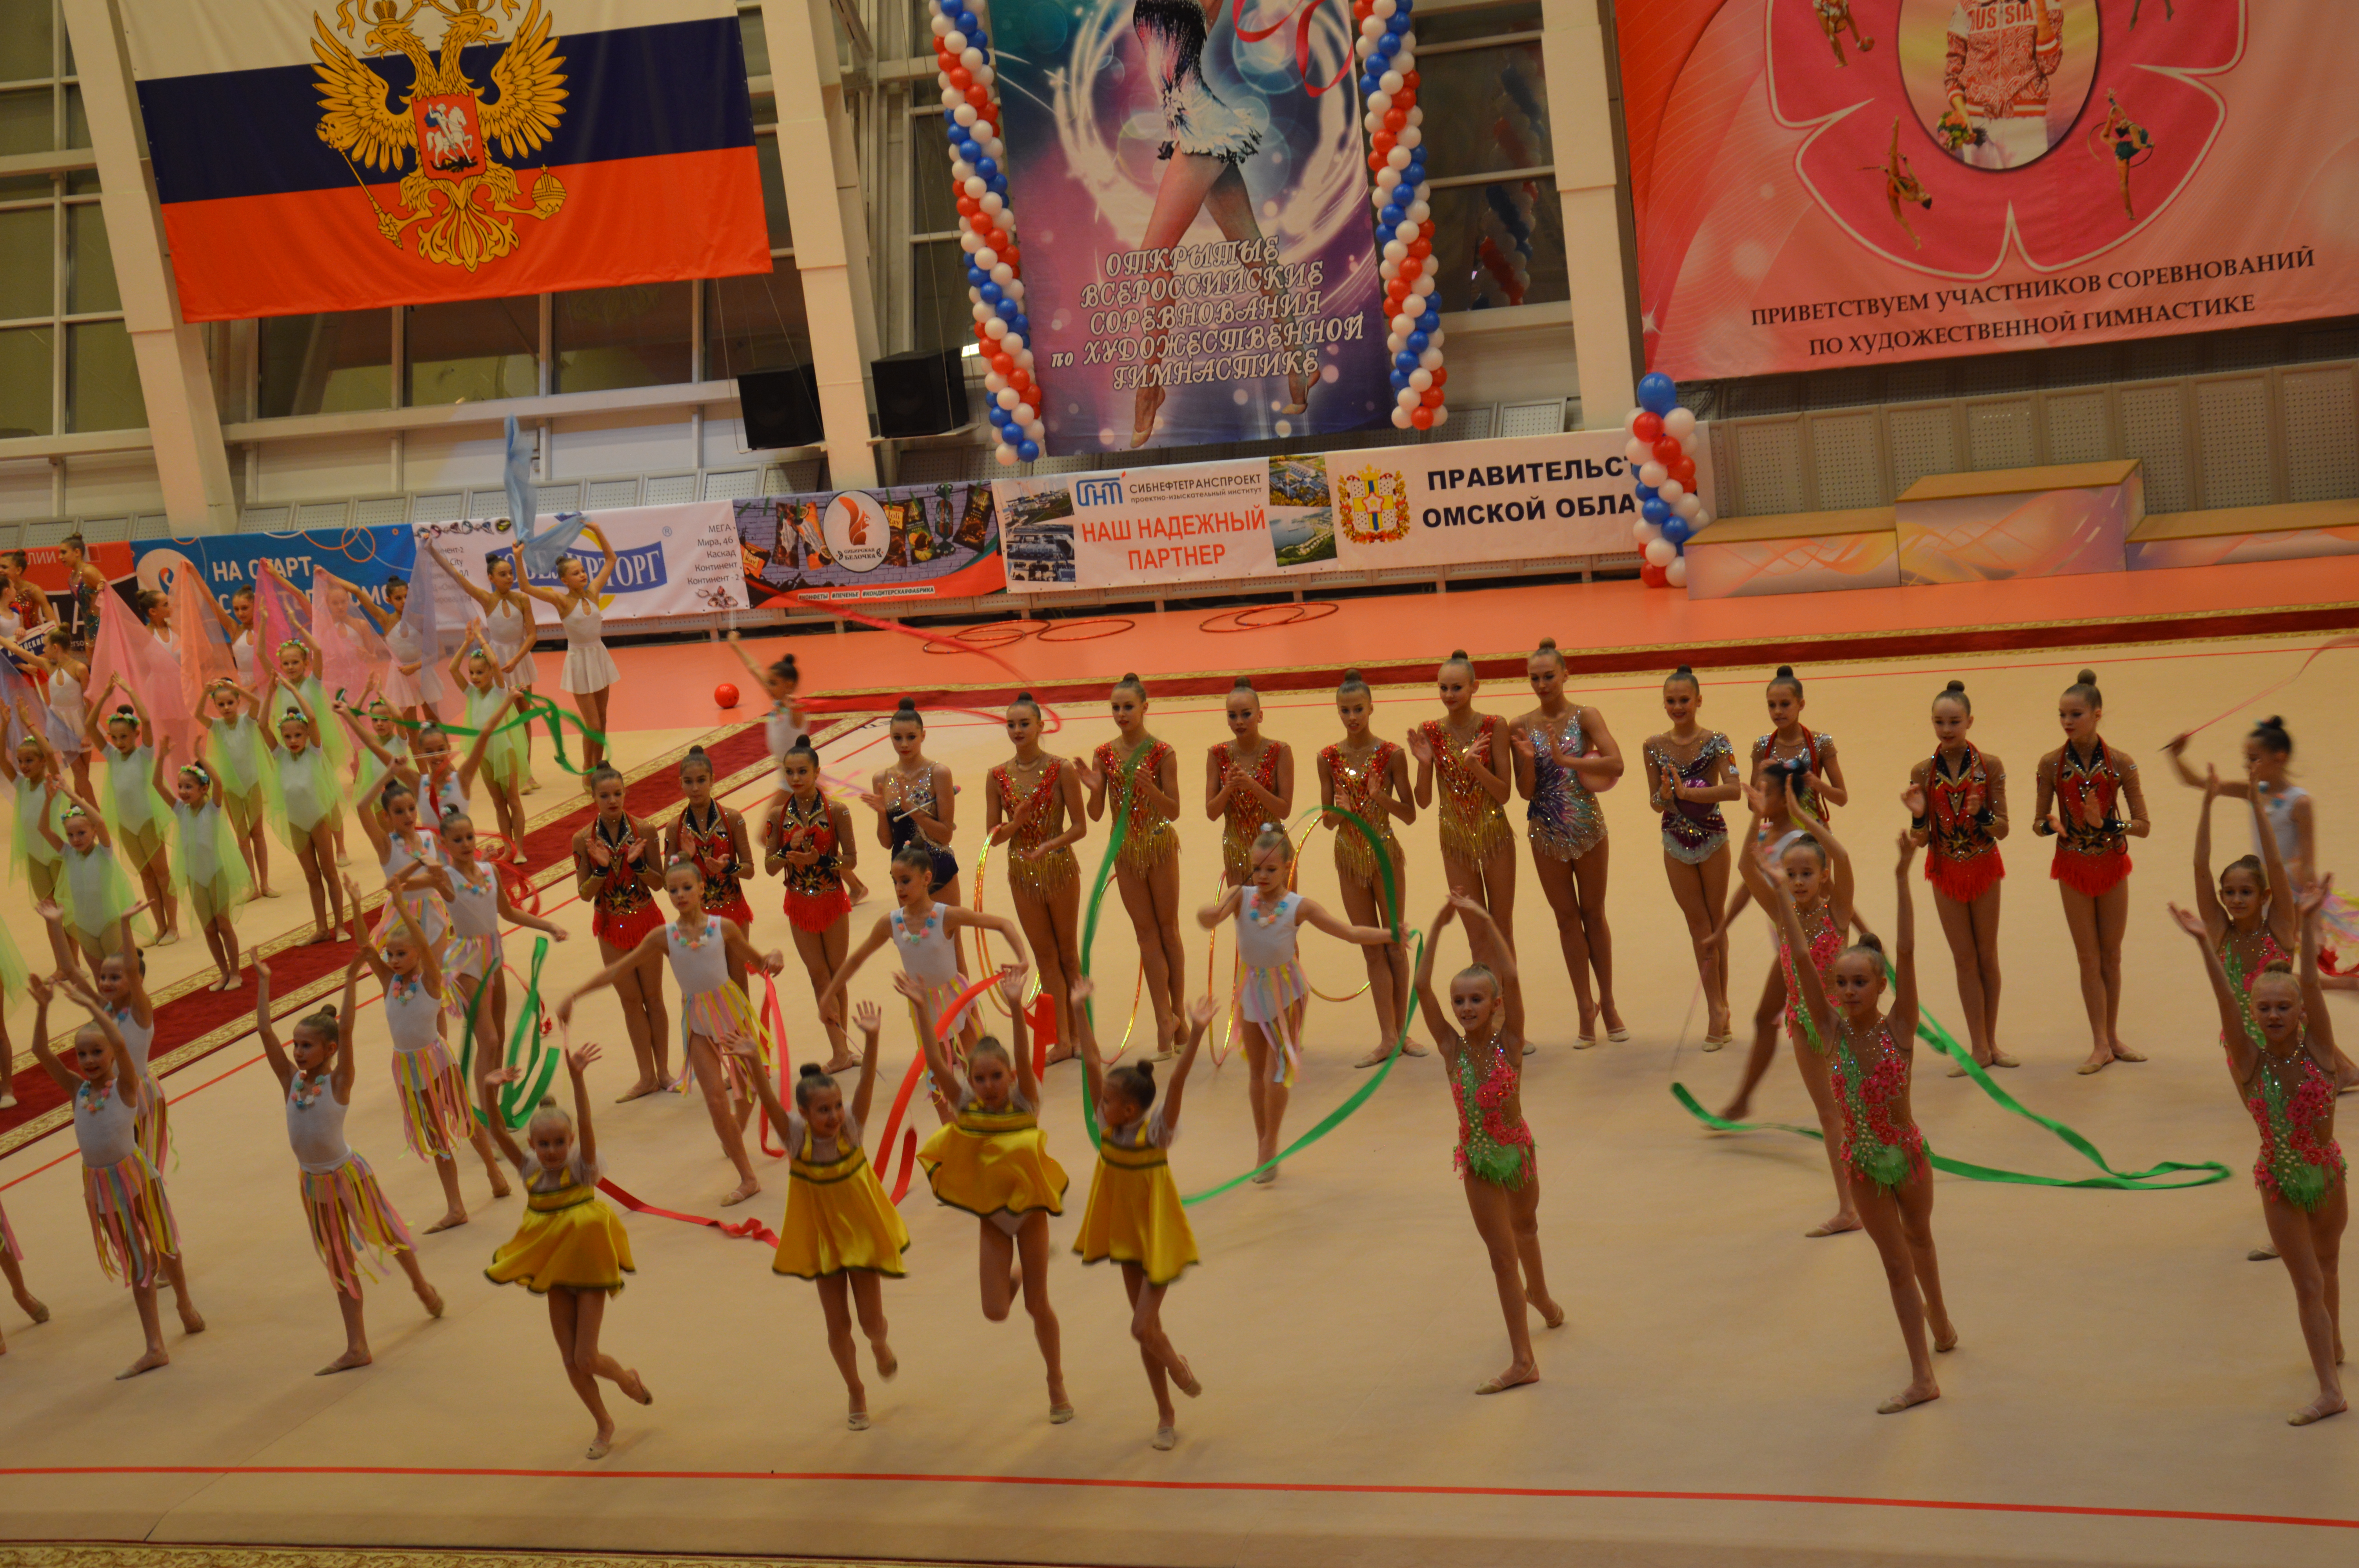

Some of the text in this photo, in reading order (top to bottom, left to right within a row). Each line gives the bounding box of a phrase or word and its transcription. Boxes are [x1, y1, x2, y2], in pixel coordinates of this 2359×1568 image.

[1105, 236, 1279, 277] ОТКРЫТЫЕ
[1080, 261, 1324, 309] ВСЕРОССИЙСКИЕ
[1751, 245, 2315, 325] ПРИВЕТСТВУЕМ УЧАСТНИКОВ СОРЕВНОВАНИЙ
[1090, 290, 1321, 335] СОРЕВНОВАНИЯ
[1810, 294, 2255, 356] ПО ХУДОЖЕСТВЕННОЙ ГИМНАСТИКЕ
[1051, 311, 1364, 368] по ХУДОЖЕСТВЕННОЙ
[1113, 348, 1319, 391] ГИМНАСТИКЕ
[1129, 474, 1261, 494] СИБНЕФТЕТРАНСПРОЕКТ
[1228, 487, 1261, 496] институт
[1082, 504, 1266, 543] НАШ НАДЕЖНЫЙ
[1422, 493, 1636, 528] ОМСКОЙ ОБЛА
[698, 536, 733, 547] Мира, 46
[709, 524, 731, 533] МЕГА
[450, 558, 463, 567] City
[695, 562, 737, 572] Континент
[707, 550, 736, 558] Каскад
[1129, 543, 1226, 570] ПАРТНЕР
[212, 556, 311, 582] НА САРТ
[687, 575, 729, 584] Континент
[862, 587, 934, 597] #КОНДИТЕРСКАЯФАБРИКА
